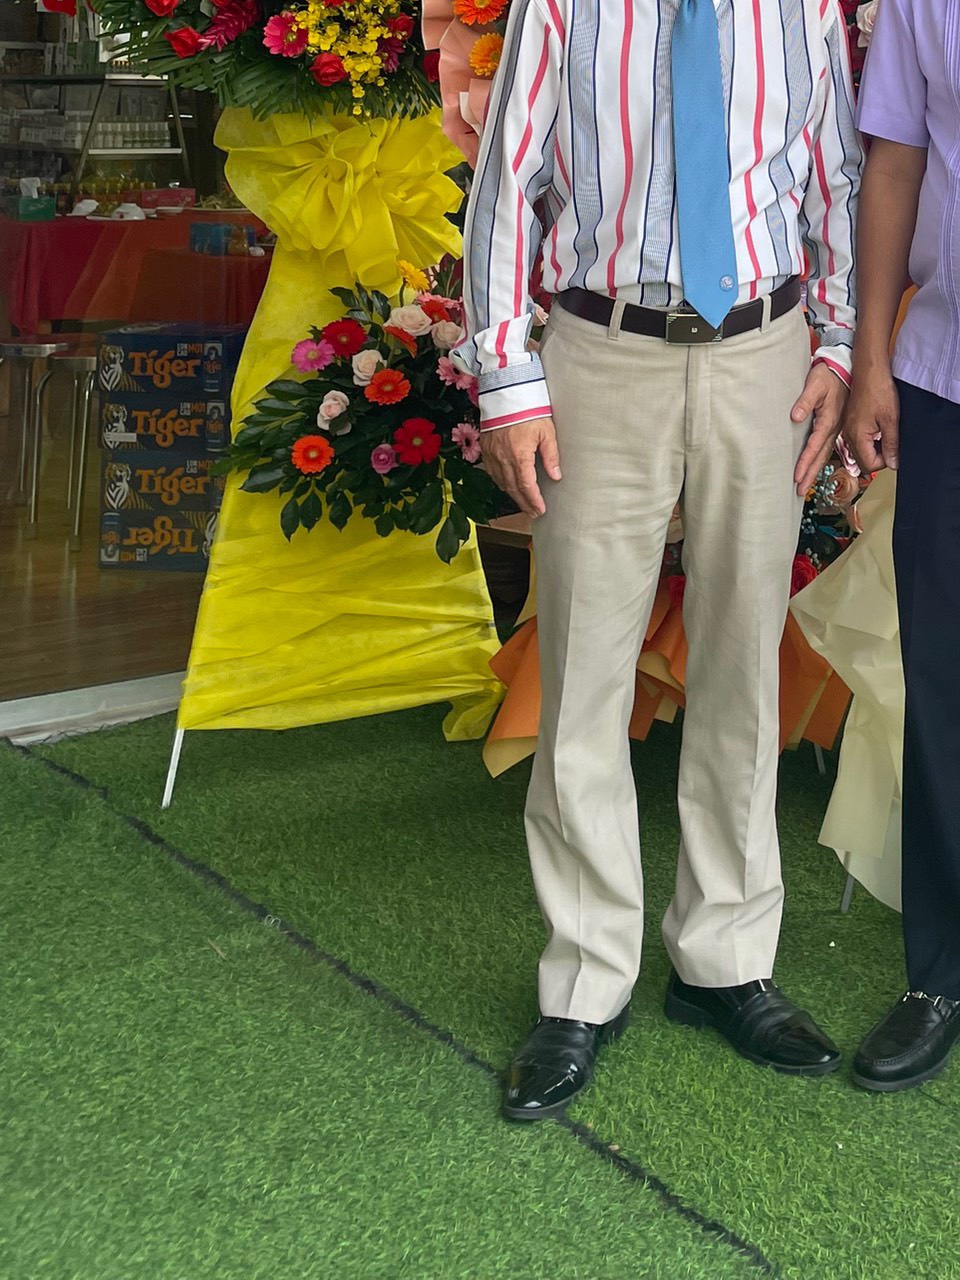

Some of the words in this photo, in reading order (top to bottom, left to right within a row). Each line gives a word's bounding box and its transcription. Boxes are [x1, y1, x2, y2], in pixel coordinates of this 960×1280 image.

[128, 350, 202, 389] Tiger
[131, 409, 204, 448] Tiger
[136, 467, 209, 506] Tiger
[123, 516, 198, 554] Tiger
